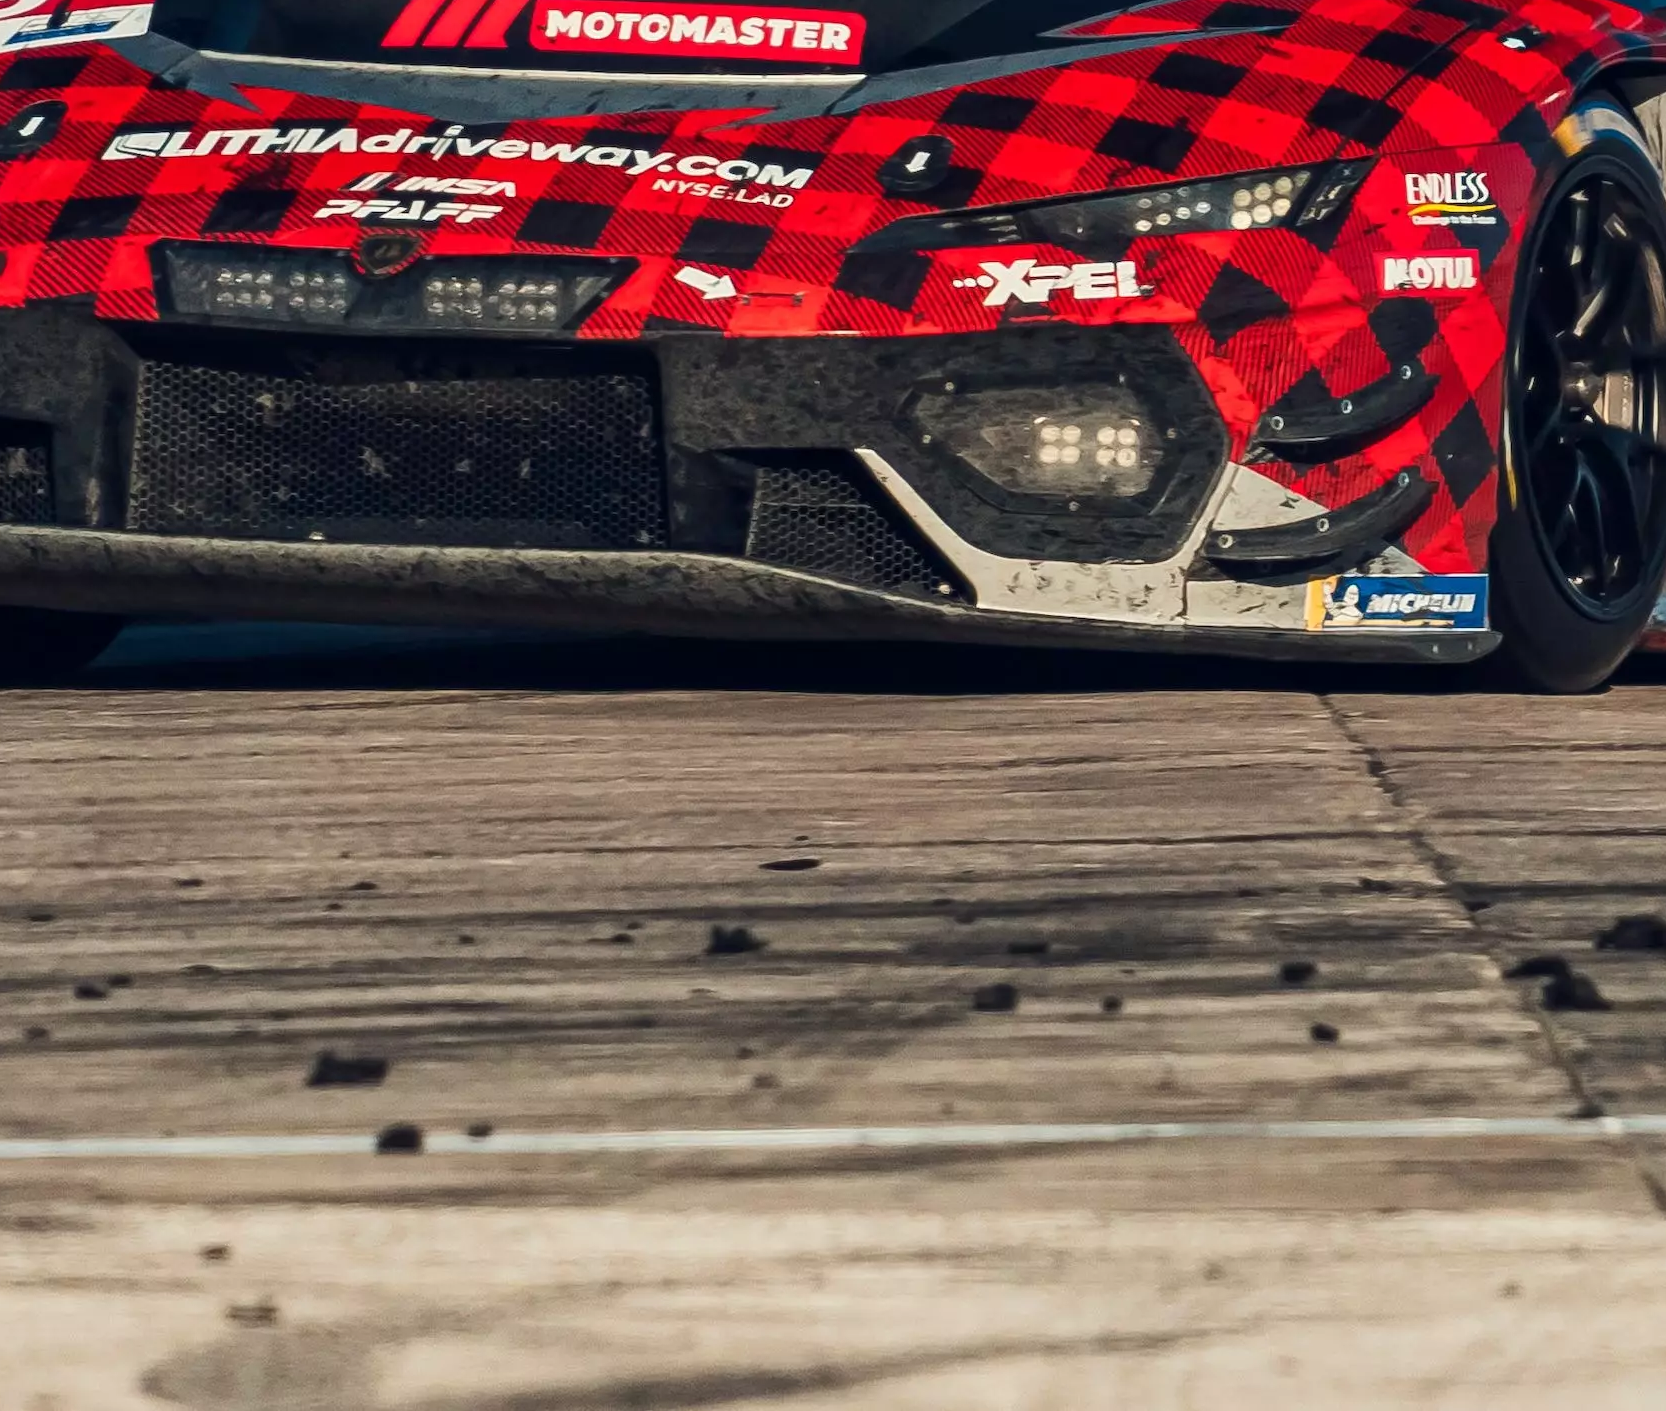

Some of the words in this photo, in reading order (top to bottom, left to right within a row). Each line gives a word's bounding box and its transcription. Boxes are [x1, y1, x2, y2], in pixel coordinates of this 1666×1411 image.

[544, 8, 852, 51] MOTOMASTER
[393, 175, 517, 198] IMSA
[651, 178, 795, 209] NYSE:LAD
[1405, 172, 1490, 205] ENDLESS
[312, 199, 504, 224] PFAFF
[978, 259, 1155, 307] XPEL
[1384, 256, 1478, 290] MOTUL
[1365, 593, 1477, 615] MICHELIN
